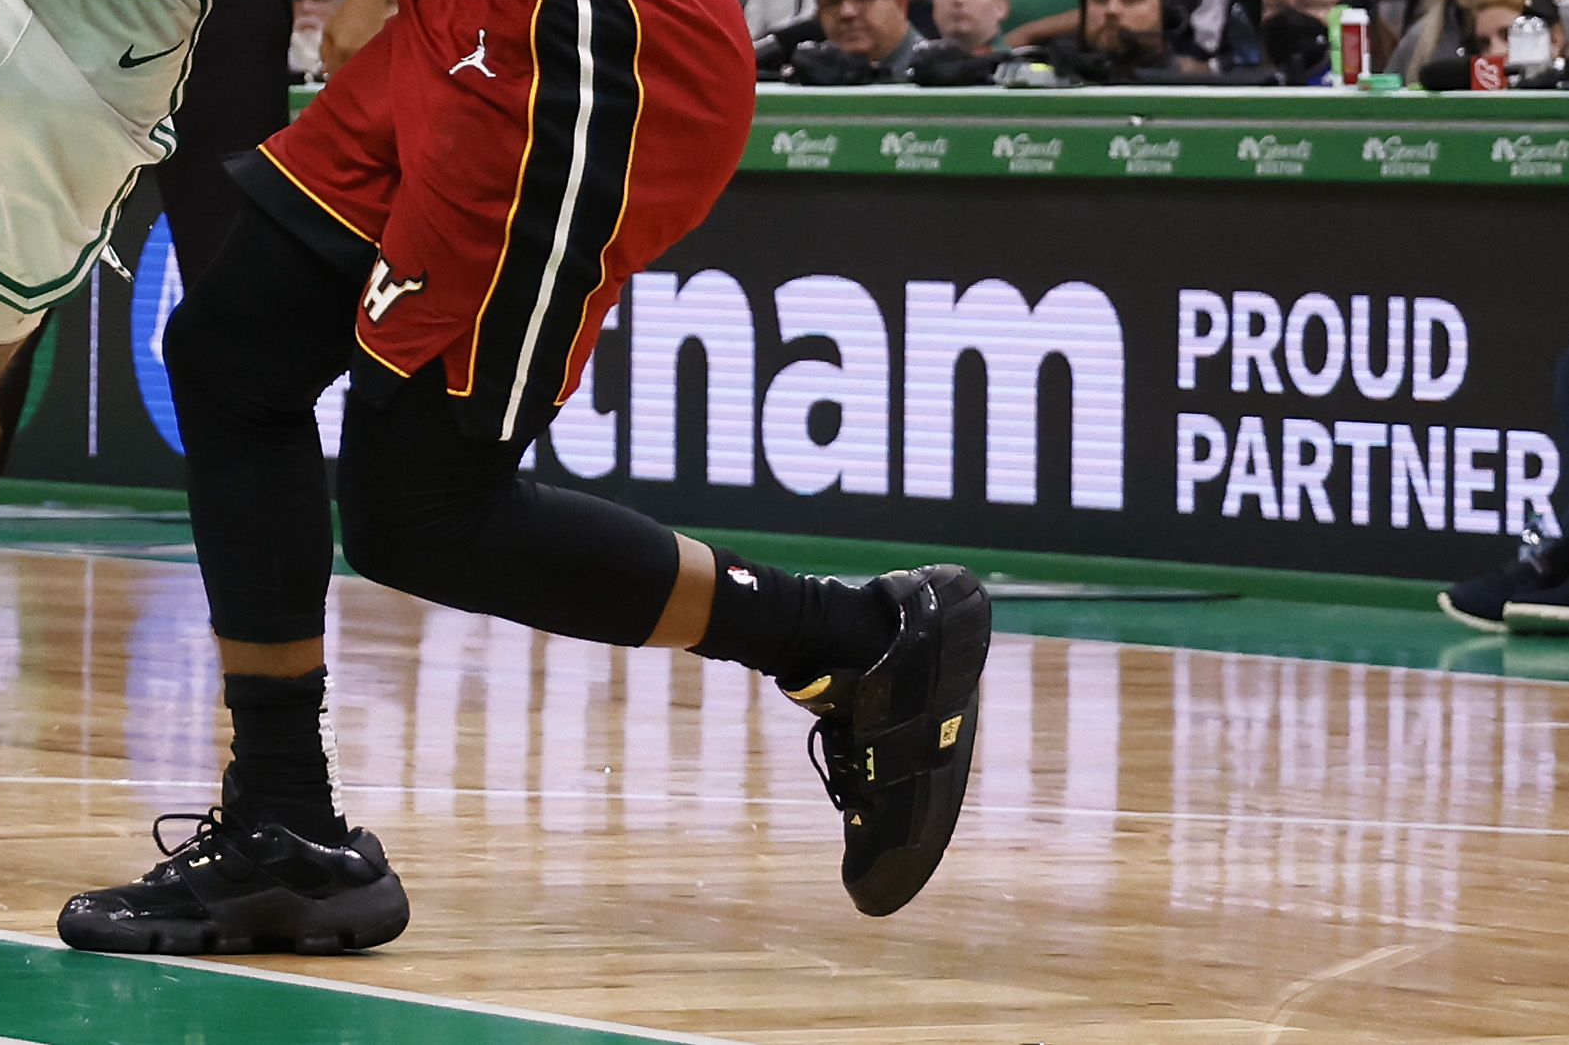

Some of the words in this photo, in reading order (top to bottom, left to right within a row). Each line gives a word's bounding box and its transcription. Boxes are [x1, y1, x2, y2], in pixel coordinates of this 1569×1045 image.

[314, 269, 1125, 512] tnam
[1177, 289, 1469, 402] PROUD
[1176, 412, 1564, 538] PARTNER
